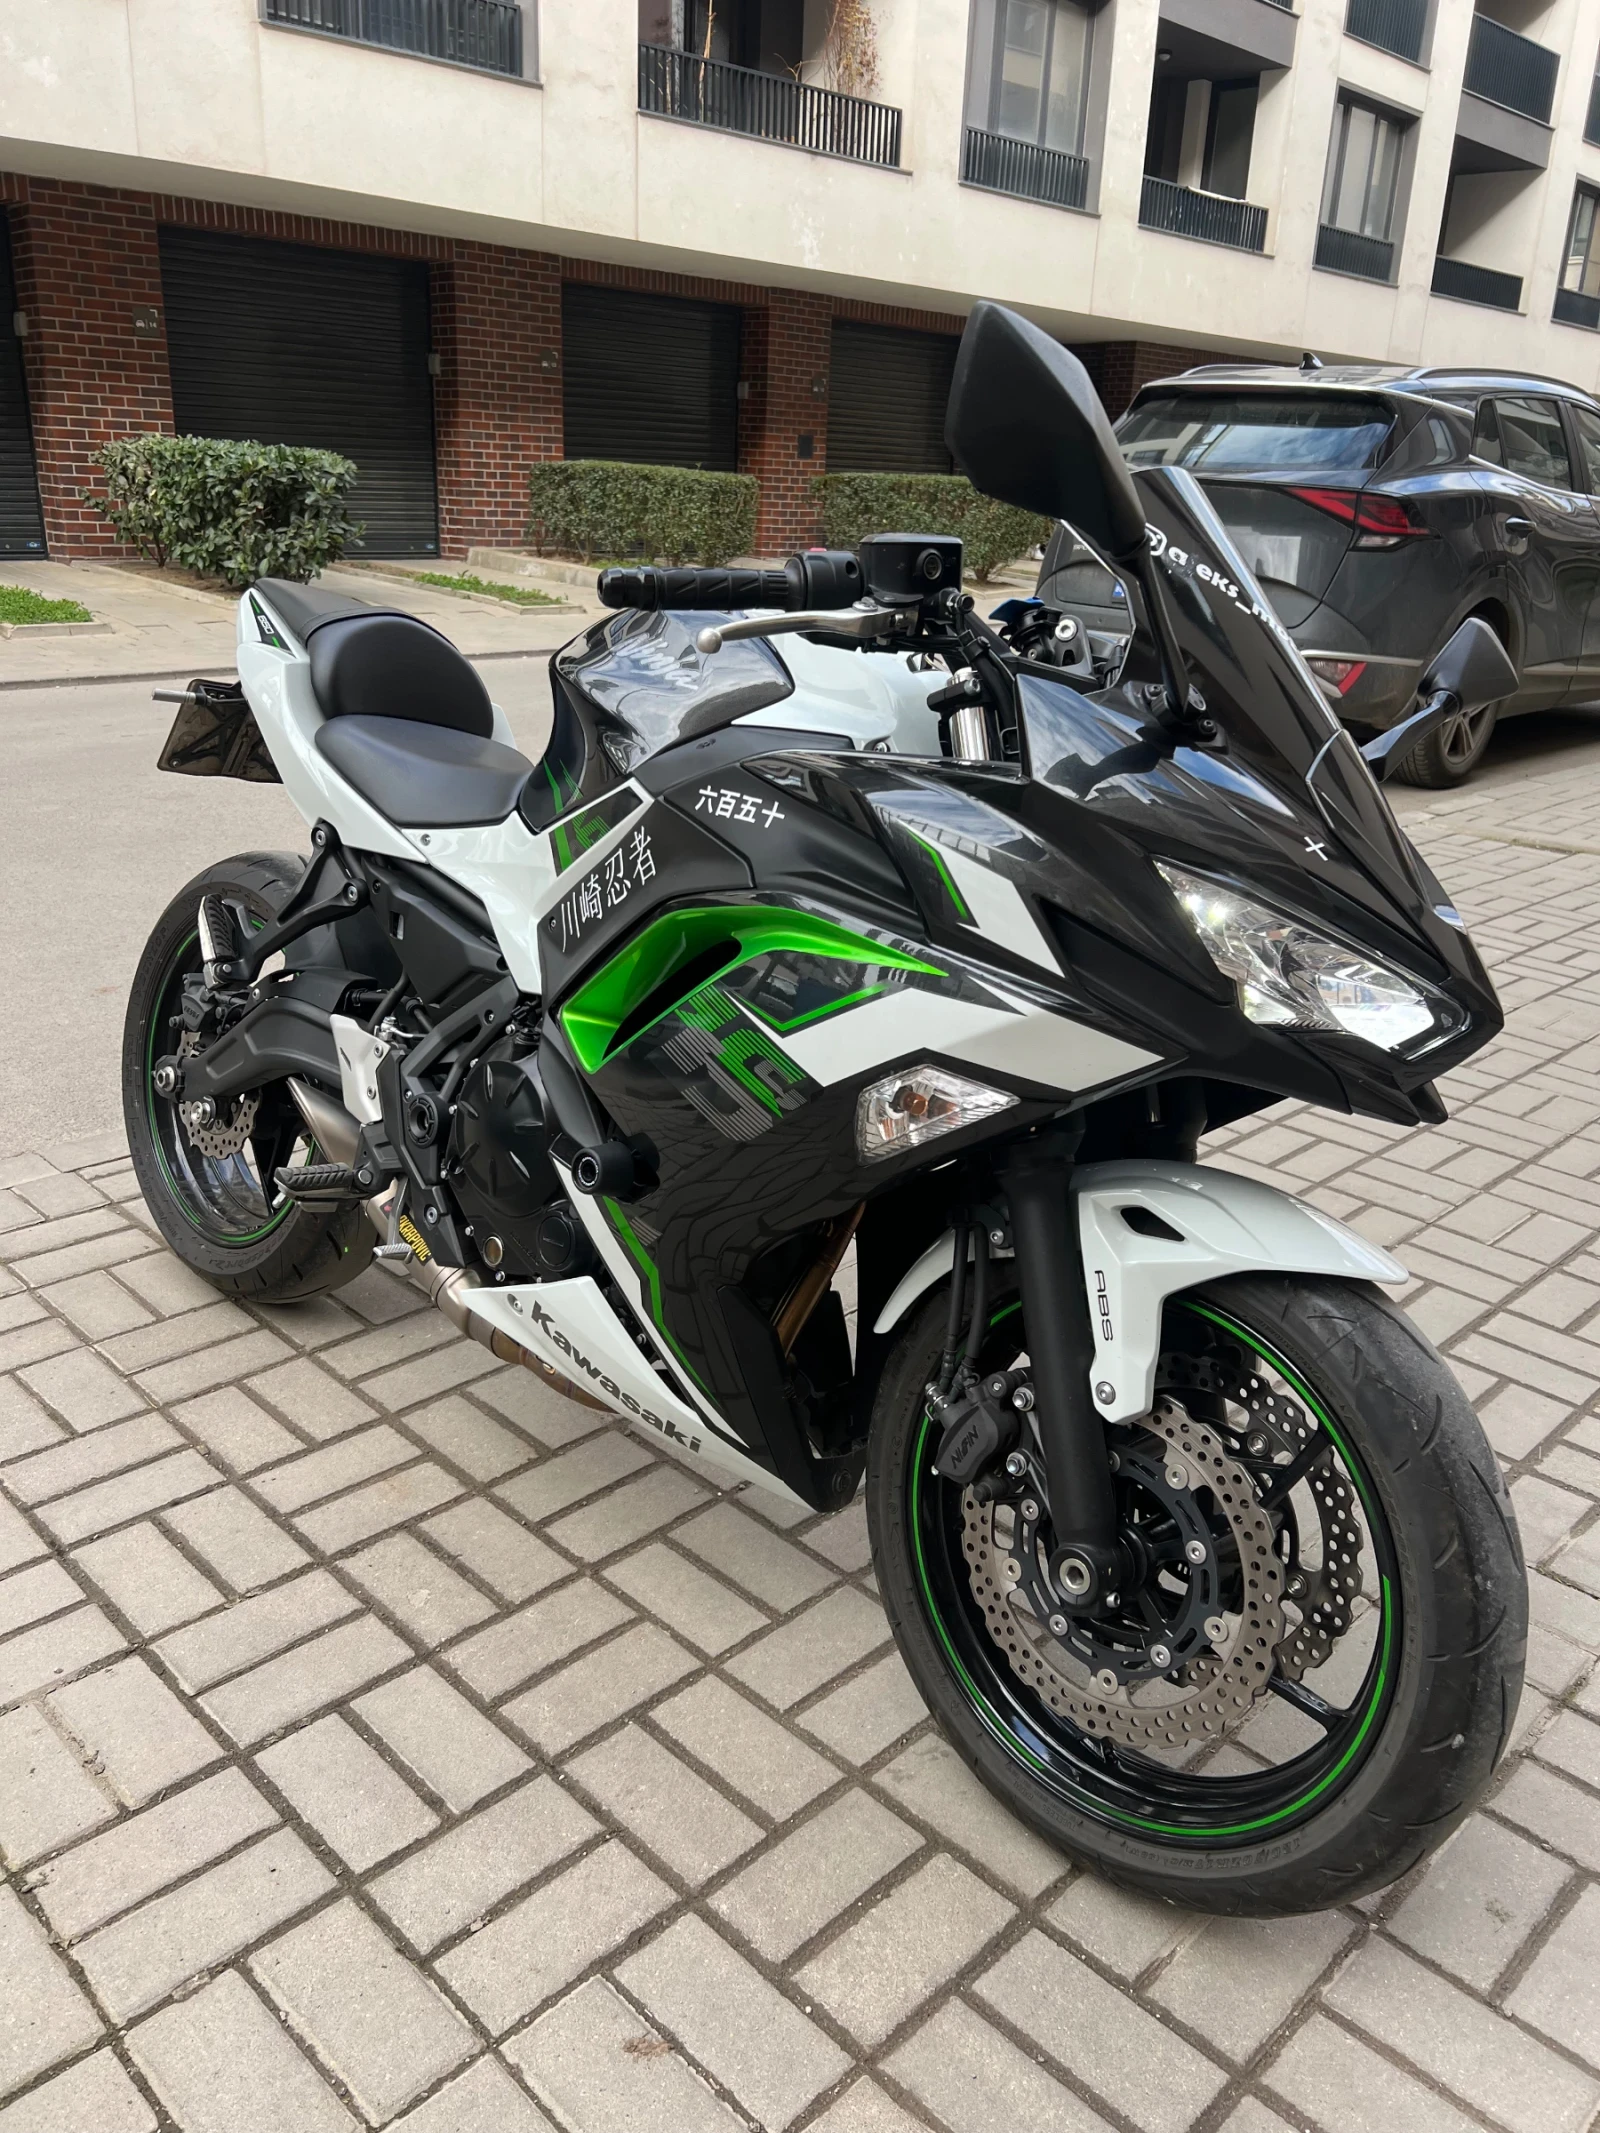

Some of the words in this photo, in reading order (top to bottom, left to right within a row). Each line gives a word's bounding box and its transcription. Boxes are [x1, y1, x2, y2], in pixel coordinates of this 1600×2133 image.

[695, 785, 785, 829] 六百五十
[561, 825, 656, 953] 川崎忍者
[1094, 1270, 1114, 1342] ABS
[531, 1299, 702, 1454] Kawasaki
